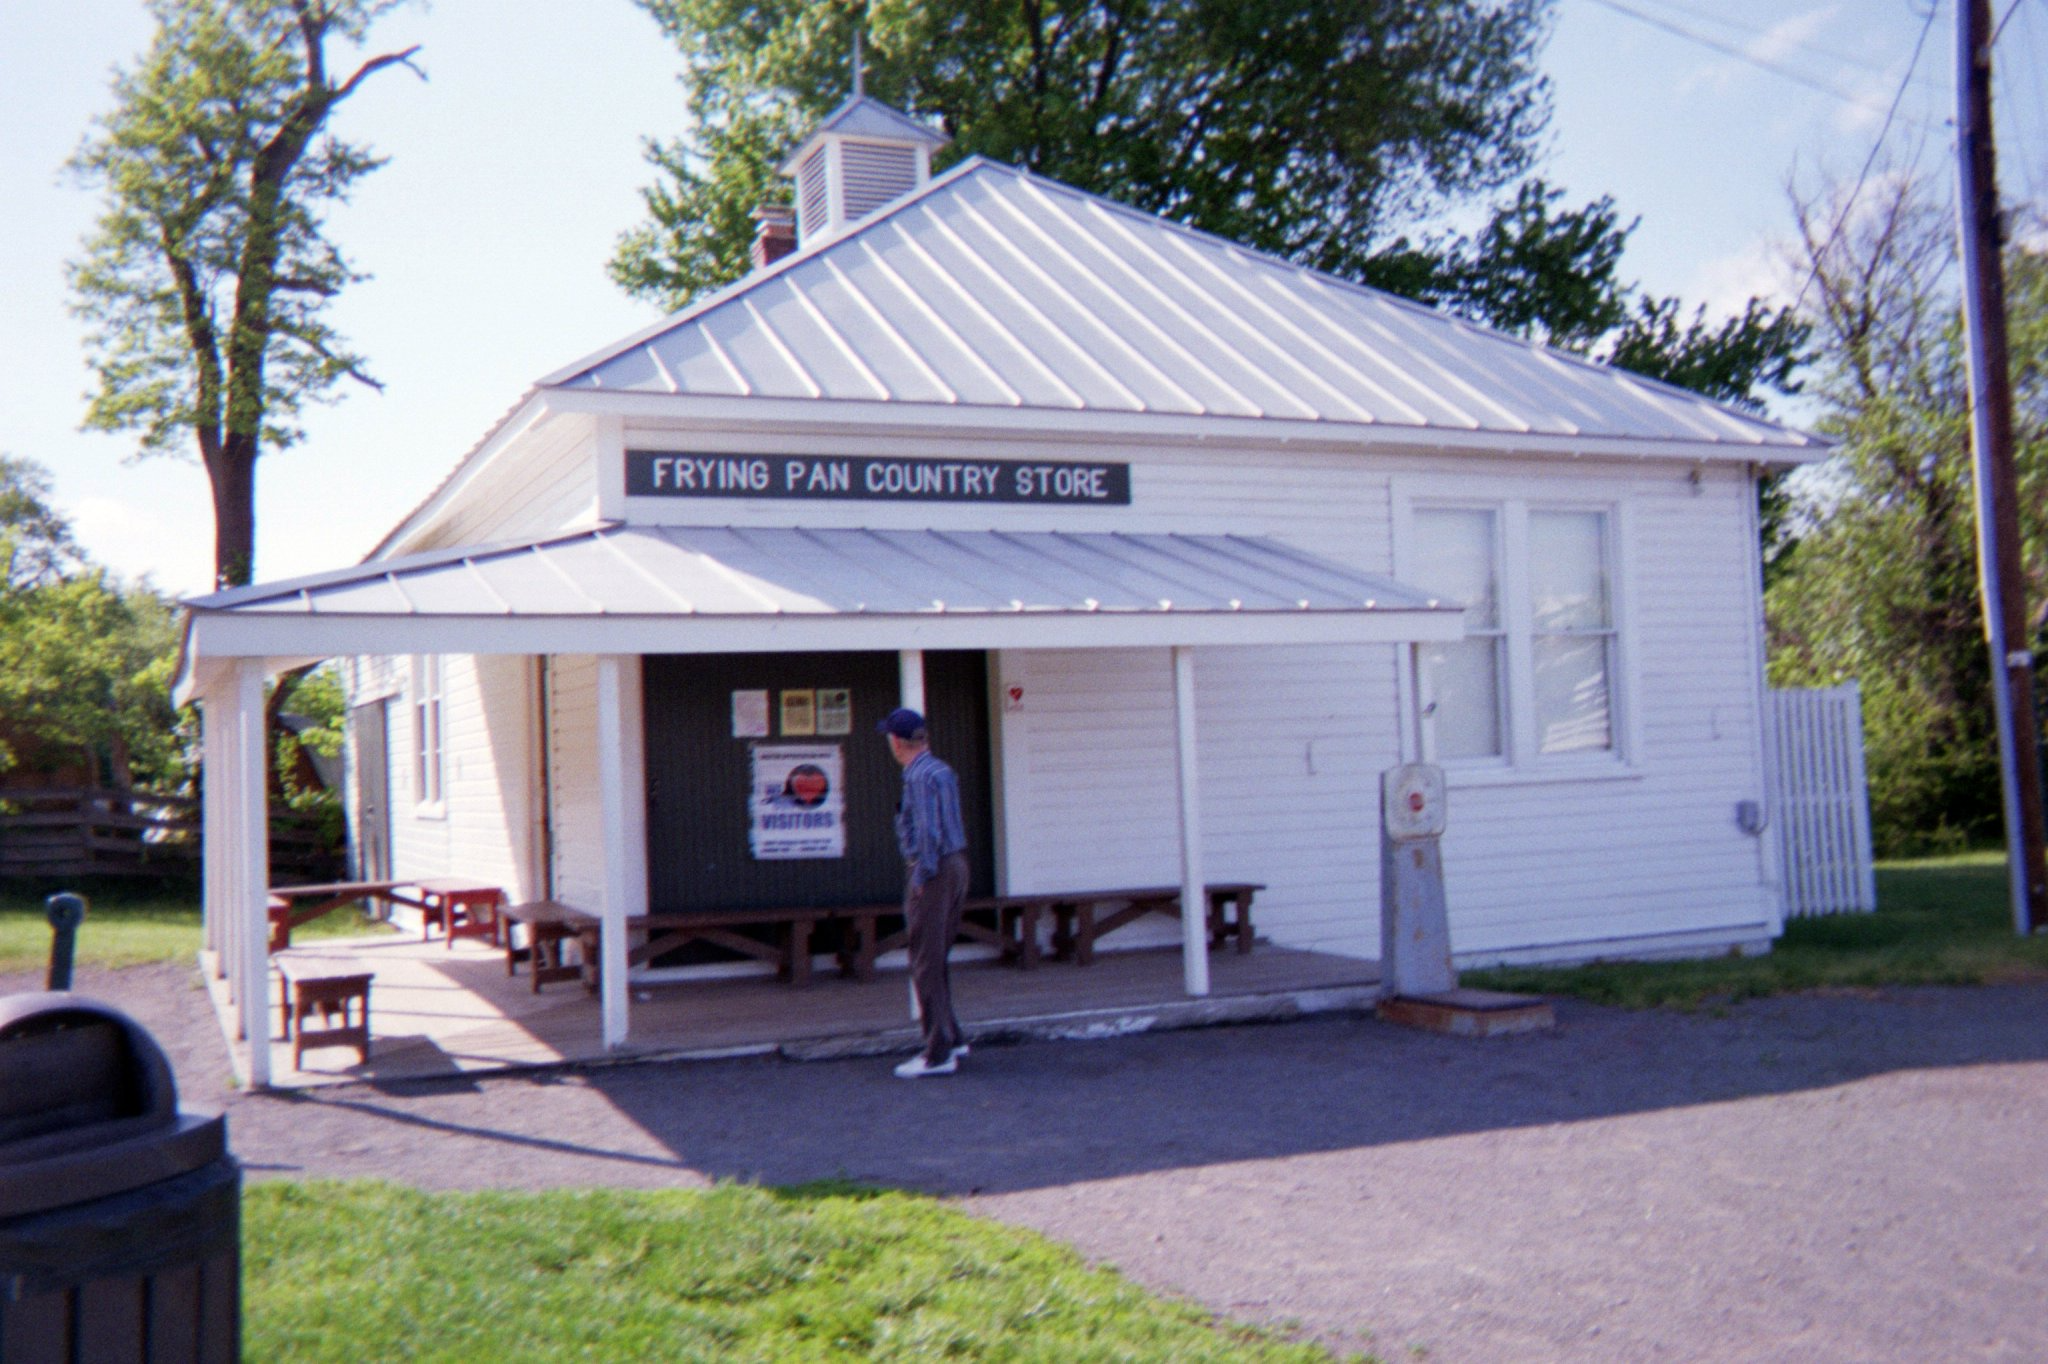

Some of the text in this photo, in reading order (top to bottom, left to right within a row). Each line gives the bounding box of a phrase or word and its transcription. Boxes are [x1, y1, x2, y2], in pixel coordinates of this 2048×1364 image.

[652, 457, 1108, 498] FRYING PAN COUNTRY STORE
[761, 812, 834, 831] VISITORS
